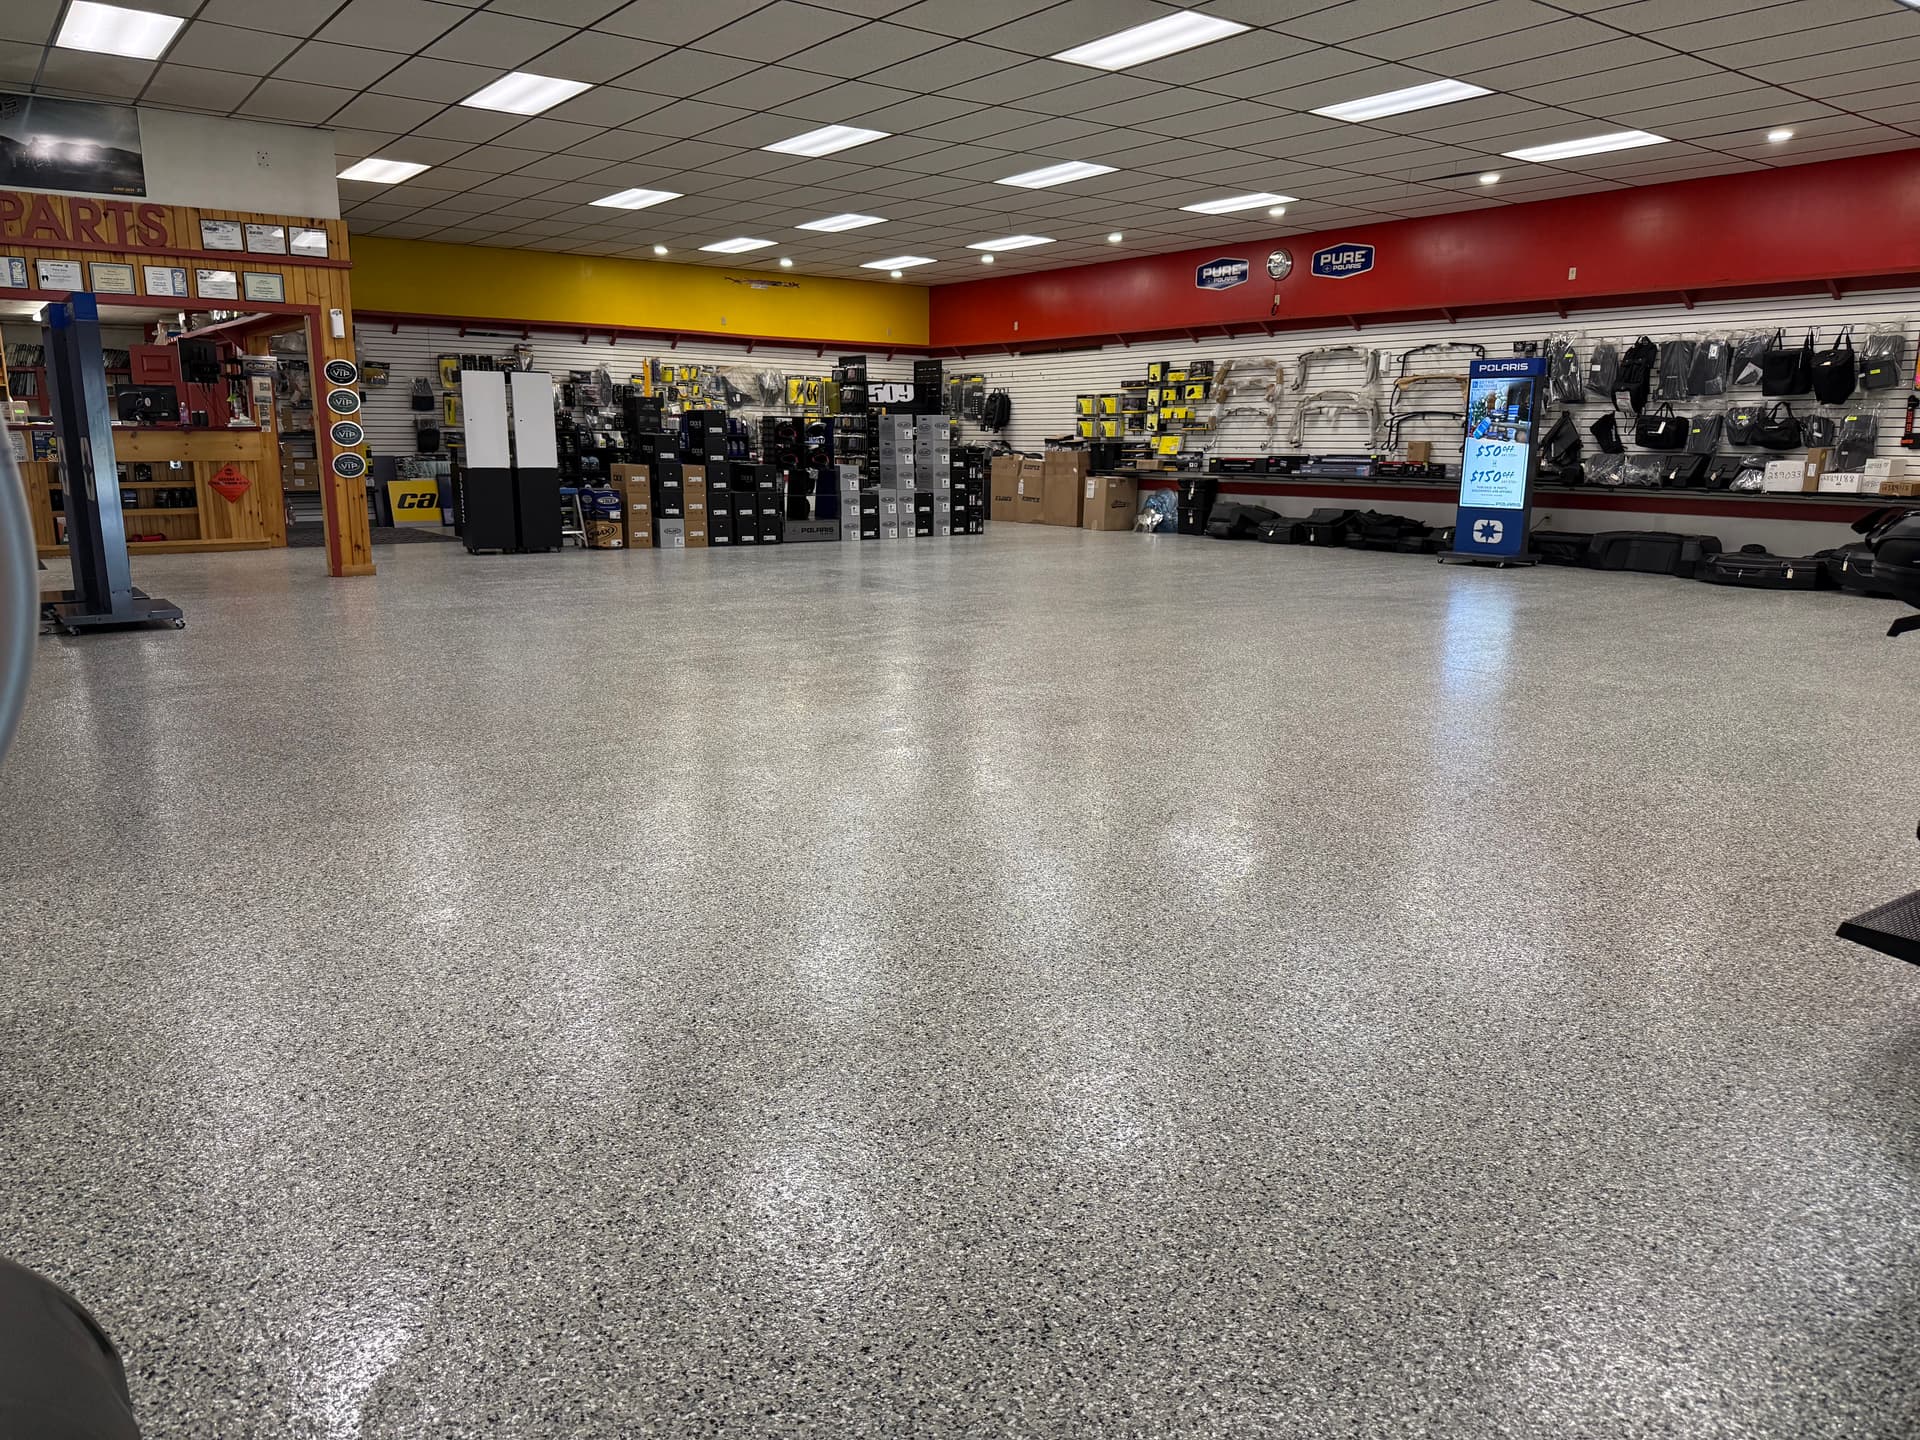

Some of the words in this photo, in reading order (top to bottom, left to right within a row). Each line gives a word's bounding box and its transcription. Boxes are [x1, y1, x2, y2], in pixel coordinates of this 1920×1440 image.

[0, 189, 168, 247] PARTS
[1320, 251, 1367, 266] PURE
[1202, 264, 1242, 279] PURE
[1332, 263, 1362, 271] POLARIS
[332, 368, 350, 377] VIP
[1479, 362, 1529, 372] POLARIS
[867, 383, 914, 403] 509
[338, 430, 356, 438] VIP
[1476, 444, 1502, 458] $50
[1502, 445, 1515, 453] OFF
[341, 462, 358, 470] VIP
[1470, 470, 1502, 484] $150
[1502, 471, 1515, 479] OFF
